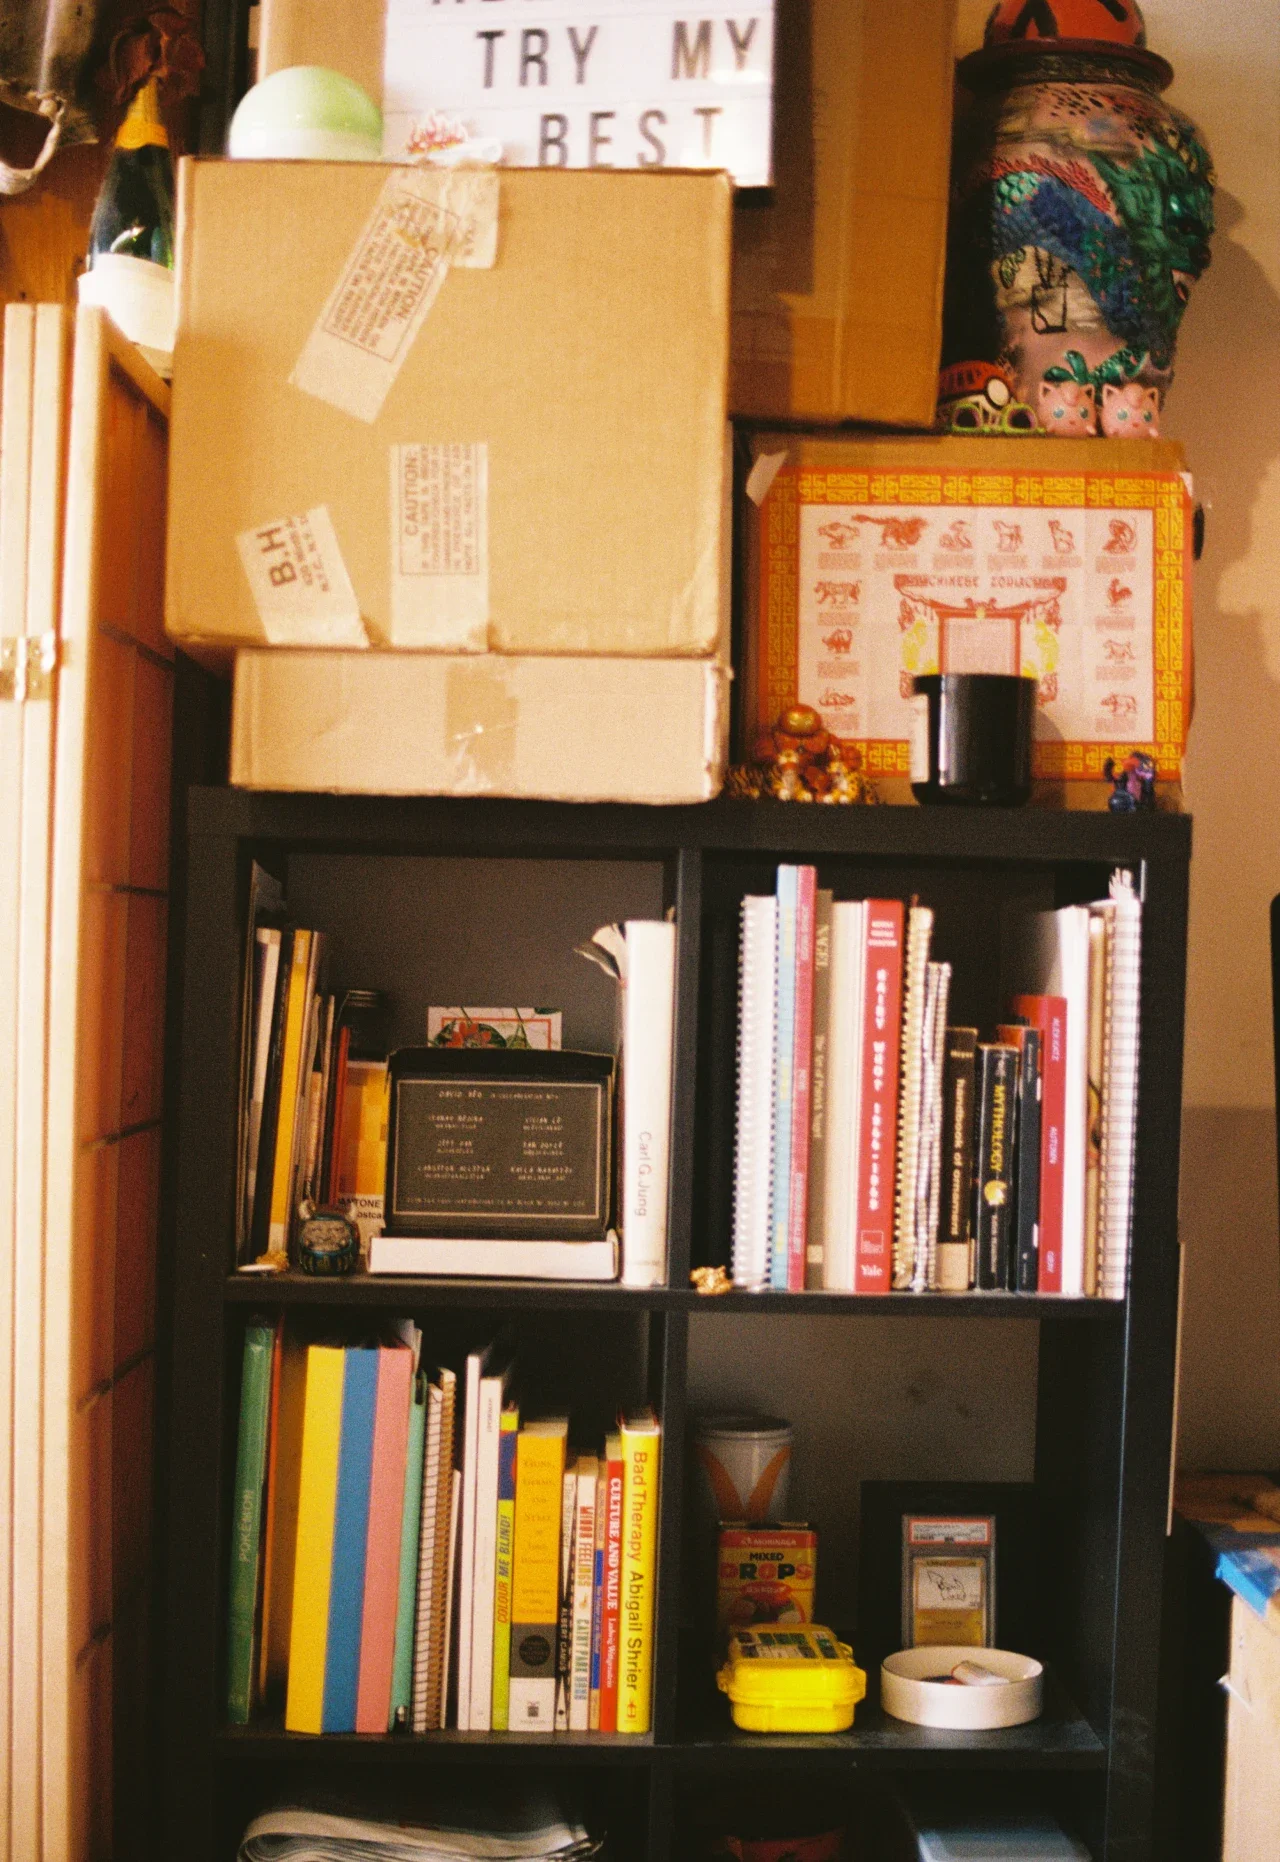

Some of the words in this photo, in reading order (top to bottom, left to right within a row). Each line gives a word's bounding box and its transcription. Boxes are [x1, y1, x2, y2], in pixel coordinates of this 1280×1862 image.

[475, 25, 599, 88] TRY
[671, 18, 759, 80] MY
[537, 106, 723, 169] BEST
[928, 575, 979, 588] CHINESE
[953, 1078, 966, 1148] handbook
[990, 1085, 1006, 1172] MYTHOLOGY
[638, 1130, 652, 1160] Carl
[953, 1152, 963, 1166] of
[637, 1164, 651, 1178] G.
[338, 1198, 382, 1208] ANTONE
[634, 1180, 651, 1217] Jung
[950, 1169, 962, 1235] ornament
[356, 1211, 382, 1219] ostca
[860, 1264, 883, 1277] Yale
[632, 1451, 648, 1485] Bad
[563, 1482, 574, 1500] The
[579, 1506, 594, 1538] MINOR
[609, 1478, 621, 1540] CULTURE
[499, 1515, 510, 1554] BLIND!
[562, 1503, 573, 1548] Stranger
[628, 1490, 647, 1562] Therapy
[753, 1537, 797, 1546] MORINAGA
[498, 1559, 509, 1577] ME
[578, 1542, 593, 1587] FEELINGS
[607, 1541, 619, 1567] AND
[749, 1552, 785, 1561] MIXED
[720, 1562, 812, 1580] DROPS
[497, 1582, 508, 1623] COLOUR
[607, 1569, 618, 1610] VALUE
[628, 1571, 643, 1632] Abigail
[559, 1607, 568, 1640] ALBERT
[576, 1619, 590, 1647] CATHY
[607, 1618, 616, 1644] Ludwig
[559, 1642, 567, 1671] CAMUS
[575, 1651, 589, 1673] PARK
[627, 1638, 642, 1691] Shrier
